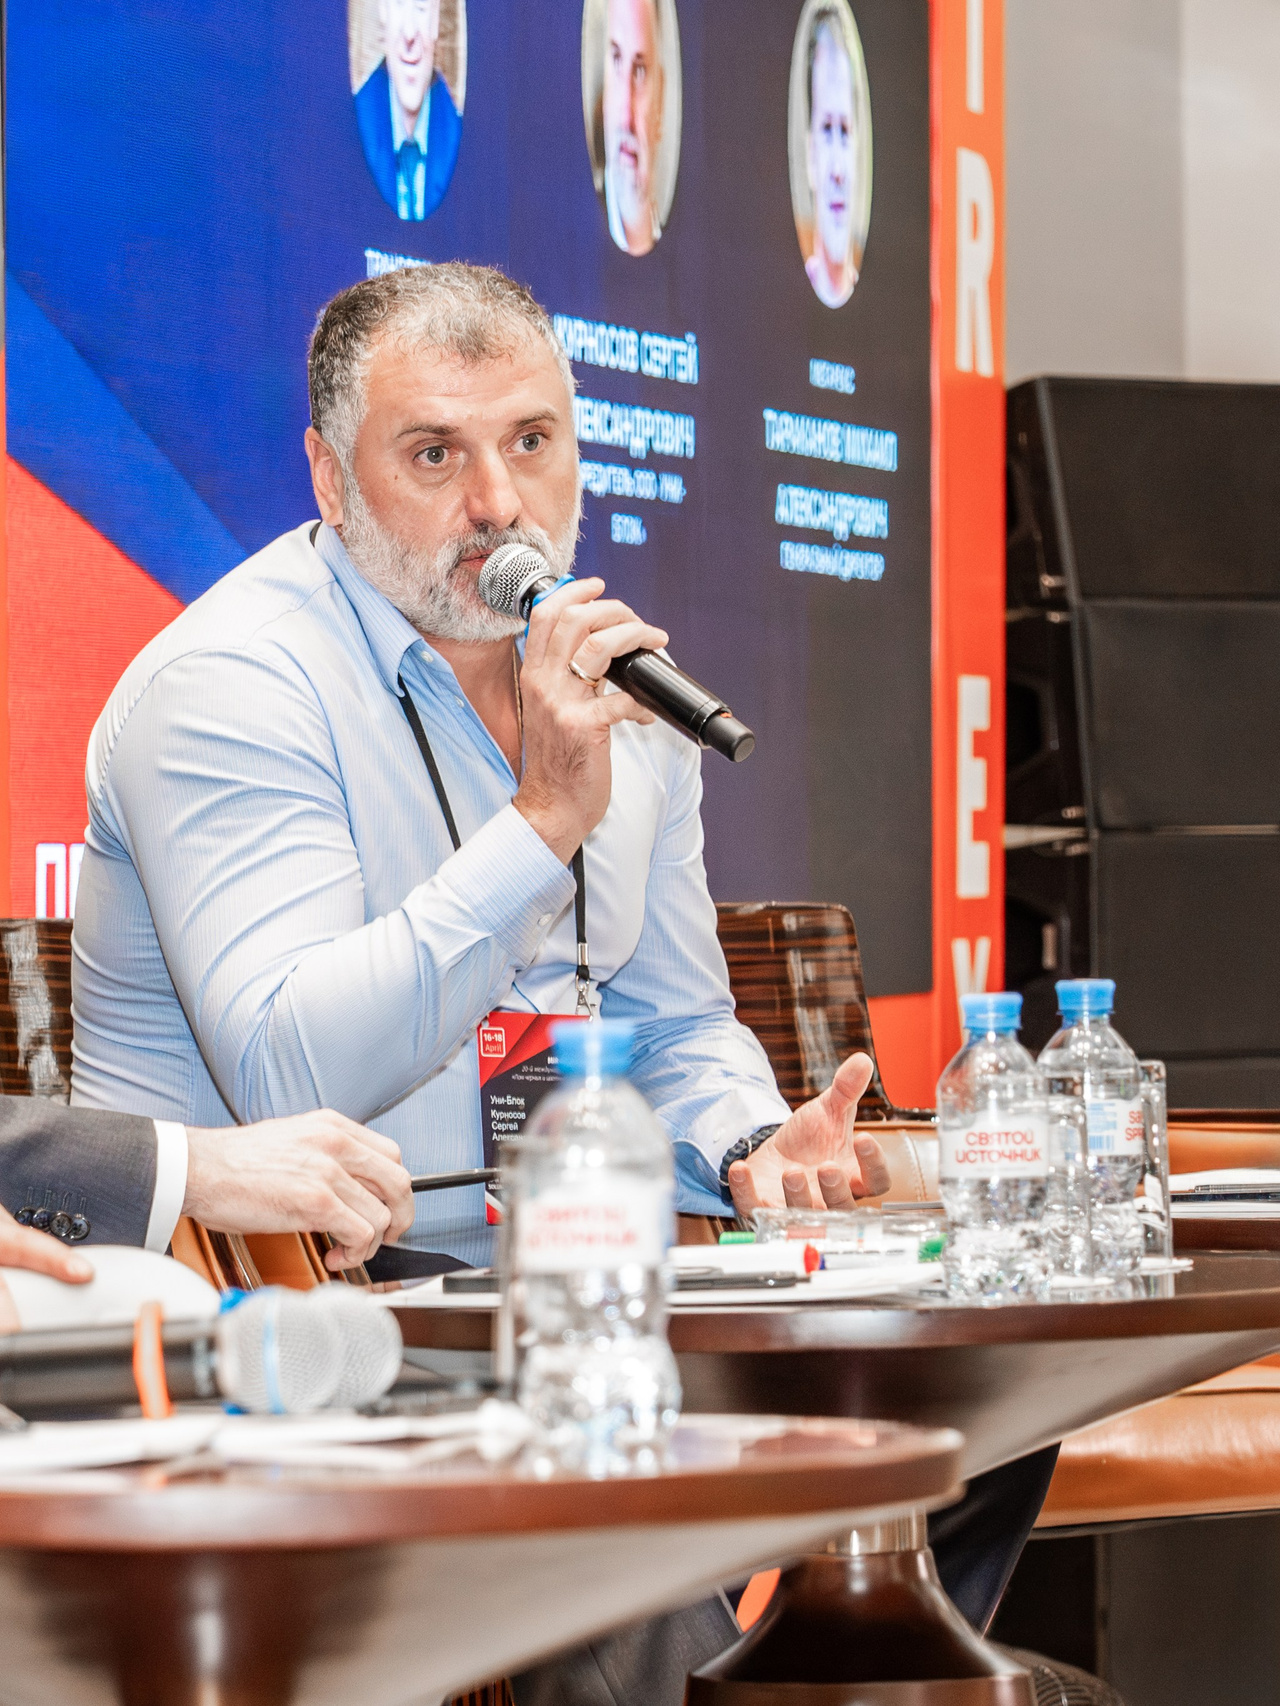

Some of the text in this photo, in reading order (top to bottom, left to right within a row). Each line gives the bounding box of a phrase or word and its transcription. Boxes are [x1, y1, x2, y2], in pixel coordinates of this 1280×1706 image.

[483, 1033, 503, 1042] 16-18
[485, 1044, 502, 1053] April
[490, 1095, 525, 1106] Уни-Блок
[490, 1109, 526, 1120] Курносов
[491, 1121, 519, 1132] Сергей
[955, 1149, 1041, 1164] ИСТОЧНИК
